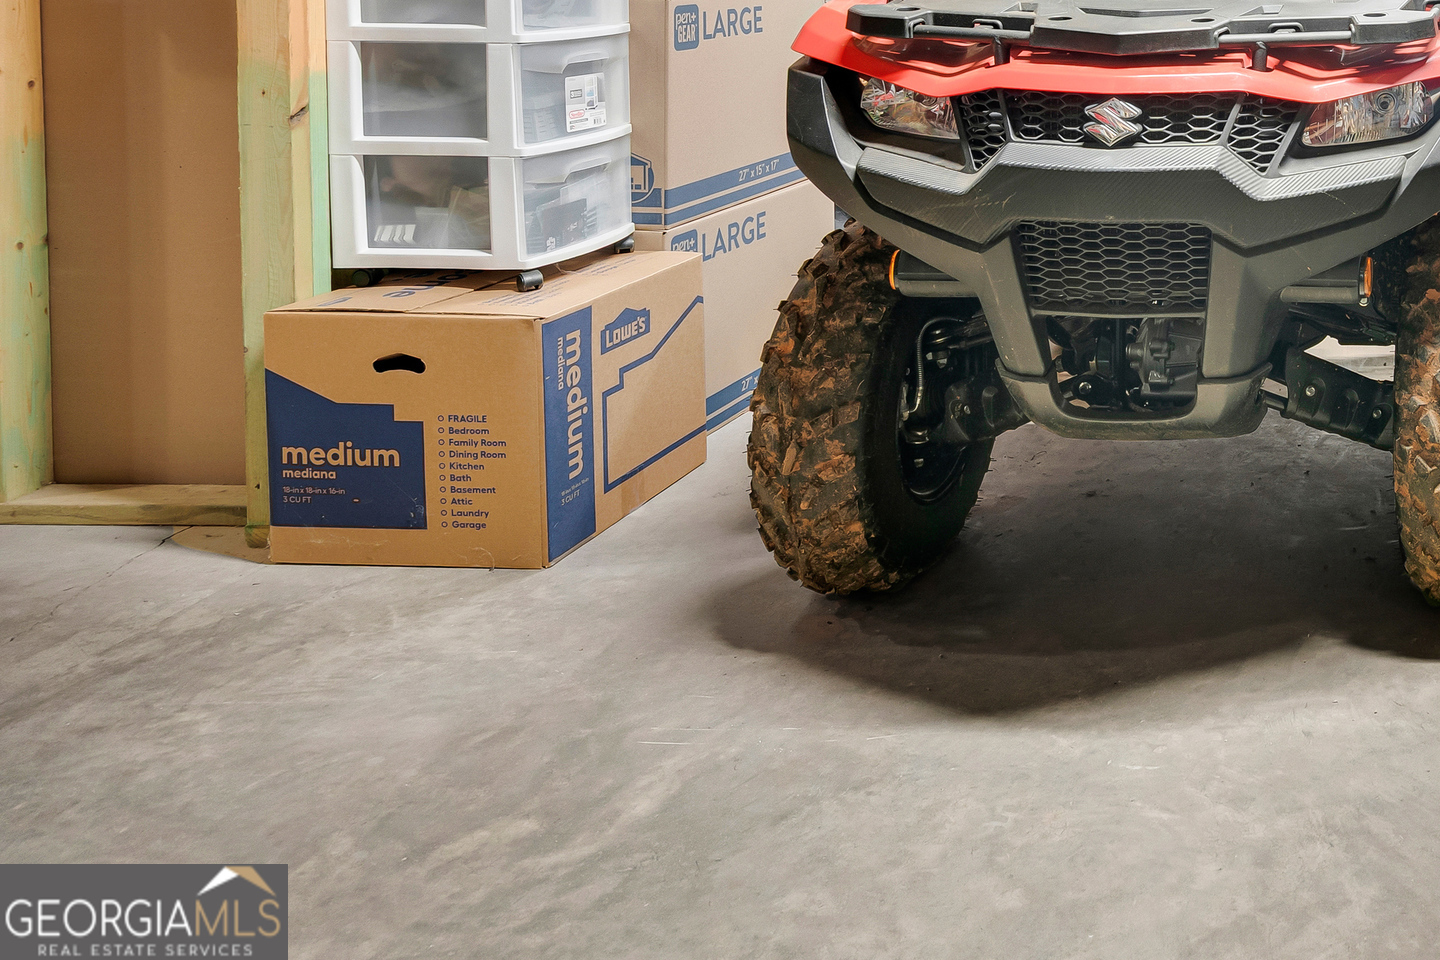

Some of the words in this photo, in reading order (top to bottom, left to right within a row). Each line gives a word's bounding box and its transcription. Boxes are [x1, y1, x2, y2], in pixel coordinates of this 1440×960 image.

[703, 6, 763, 40] LARGE
[678, 24, 696, 43] GEAR
[702, 211, 766, 262] LARGE
[606, 316, 646, 348] LOWE'S
[566, 328, 588, 480] medium
[448, 415, 487, 423] FRAGILE
[448, 427, 489, 435] Bedroom
[449, 439, 478, 448] Family
[282, 441, 400, 467] medium
[449, 450, 478, 460] Dining
[480, 451, 506, 459] Room
[449, 462, 484, 470] Kitchen
[282, 467, 337, 479] mediana
[450, 486, 496, 494] Basement
[451, 509, 489, 518] Laundry
[452, 520, 487, 530] Garage
